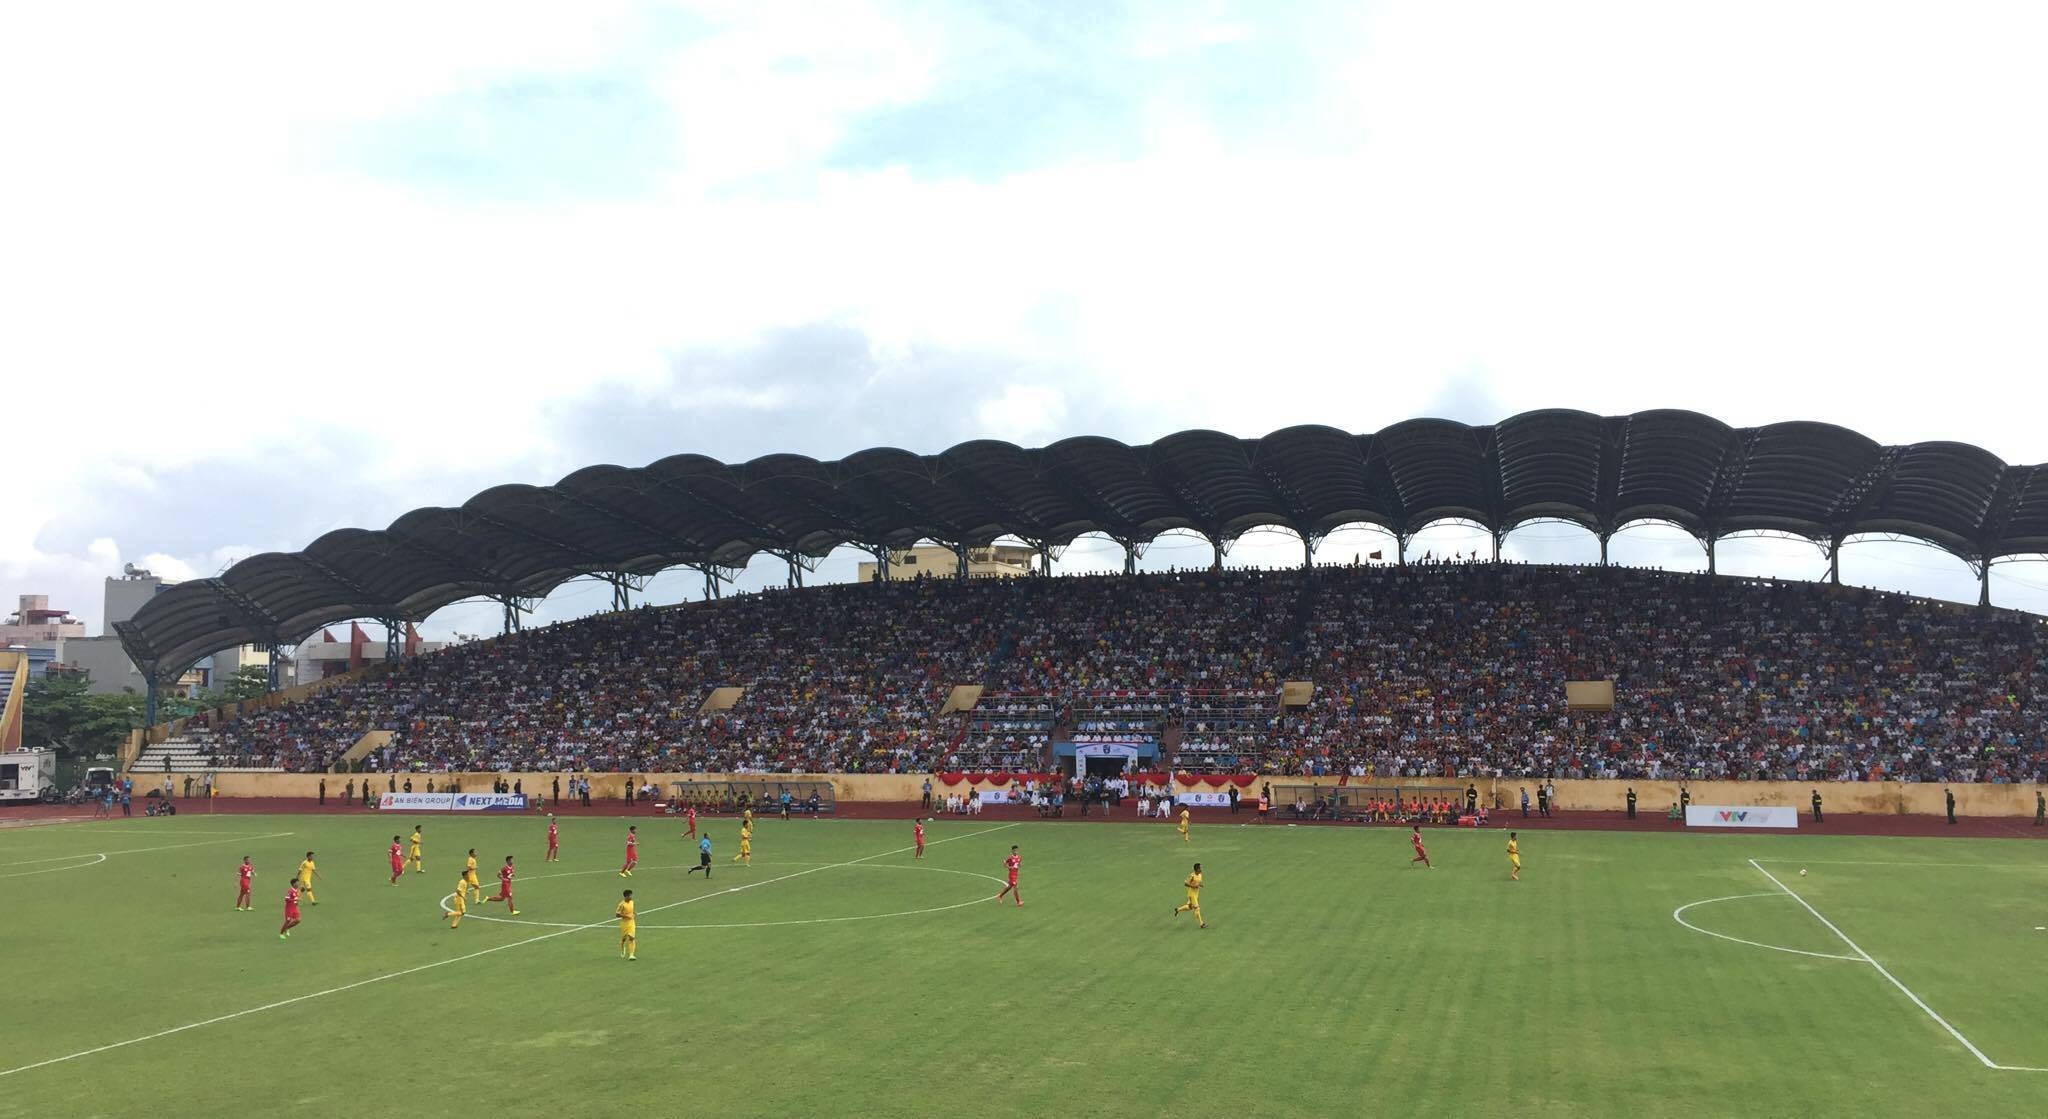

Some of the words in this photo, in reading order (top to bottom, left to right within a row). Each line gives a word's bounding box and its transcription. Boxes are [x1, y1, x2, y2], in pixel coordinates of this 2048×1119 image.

[469, 796, 492, 805] NEXT
[494, 796, 524, 806] MEDIA
[1720, 811, 1747, 822] VTV
